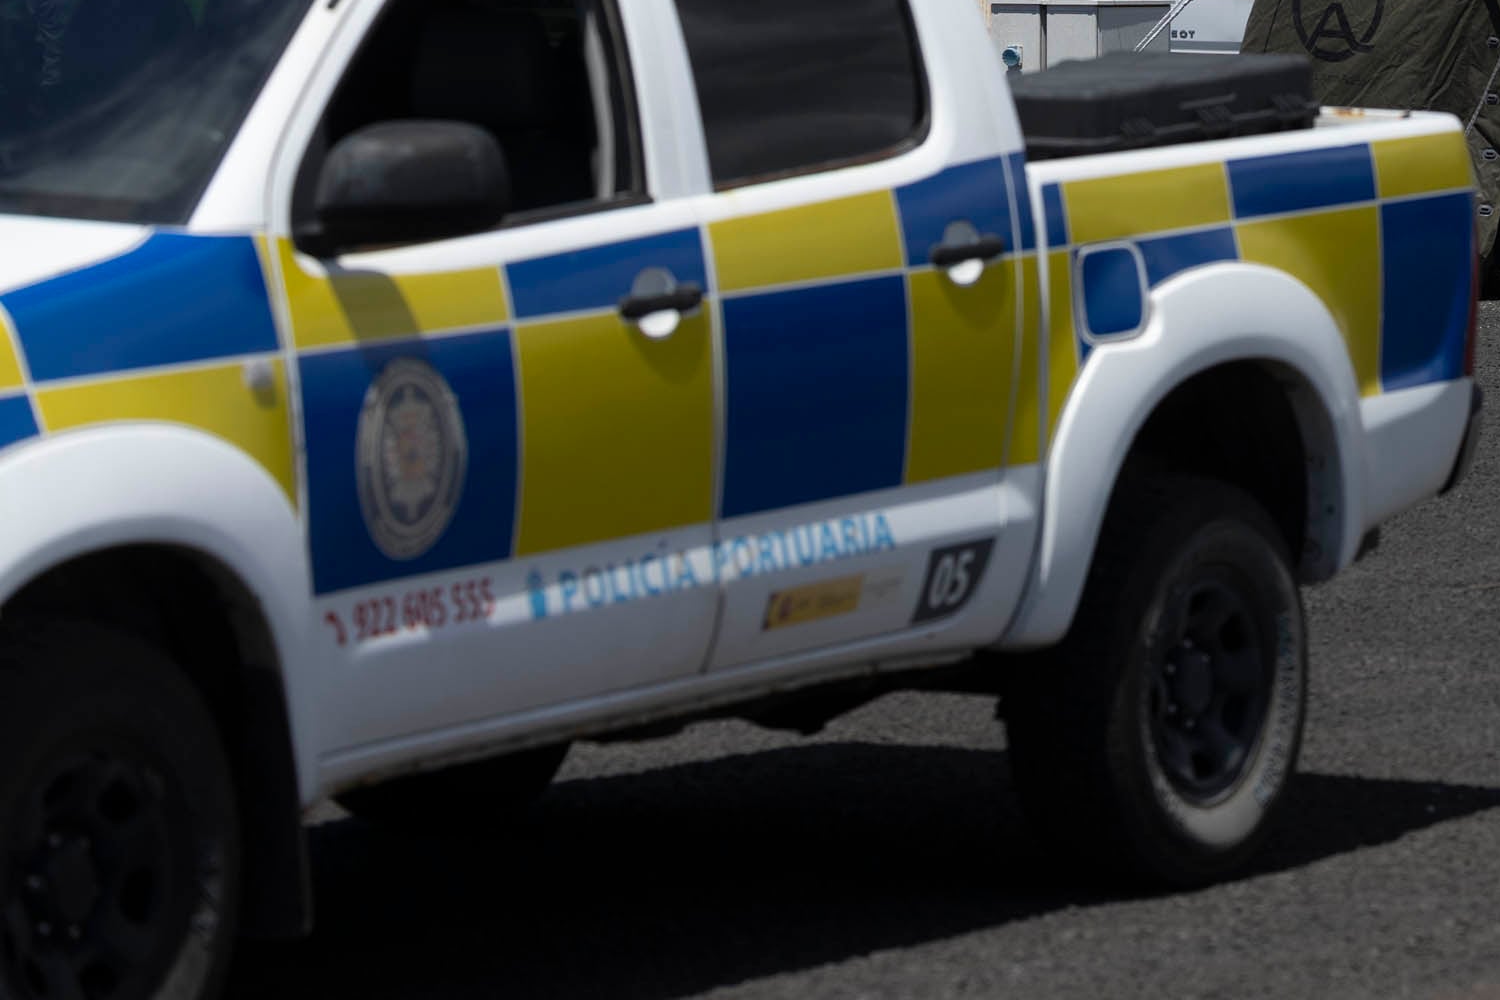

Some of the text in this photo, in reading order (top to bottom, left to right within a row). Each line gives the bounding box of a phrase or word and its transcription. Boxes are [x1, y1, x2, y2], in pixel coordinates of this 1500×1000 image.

[353, 597, 398, 641] 922
[452, 576, 496, 622] 555
[558, 539, 699, 613] POLICÍA
[711, 513, 895, 580] PORTUARIA
[926, 548, 976, 609] 05
